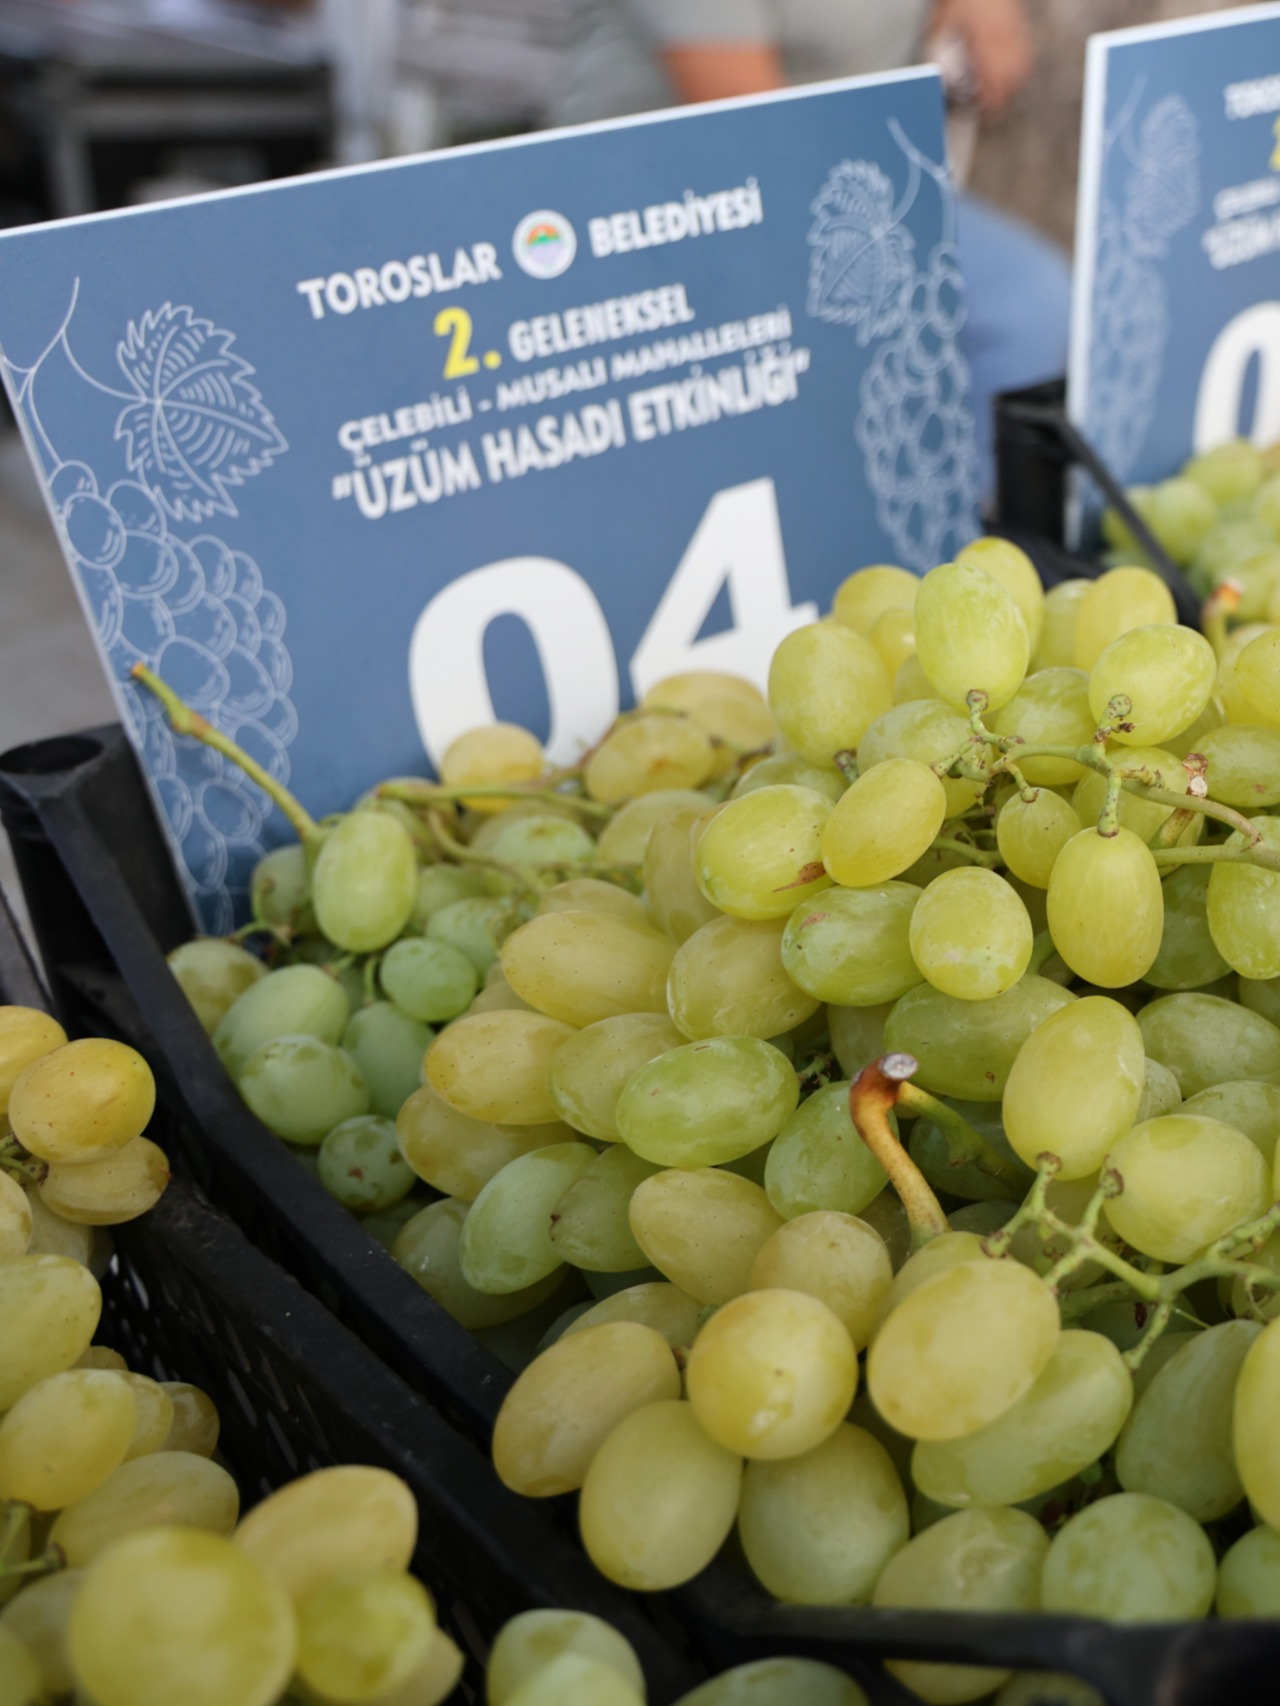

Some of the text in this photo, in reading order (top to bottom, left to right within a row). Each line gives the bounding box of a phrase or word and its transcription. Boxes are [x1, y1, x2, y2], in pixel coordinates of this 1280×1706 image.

[297, 176, 765, 320] TOROSLAR BELEDİYESİ
[433, 282, 696, 380] 2. GELENEKSEL
[338, 385, 474, 456] ÇELEBİLİ
[496, 356, 608, 412] MUSALI
[481, 398, 627, 484] HASADI
[408, 476, 819, 782] 04
